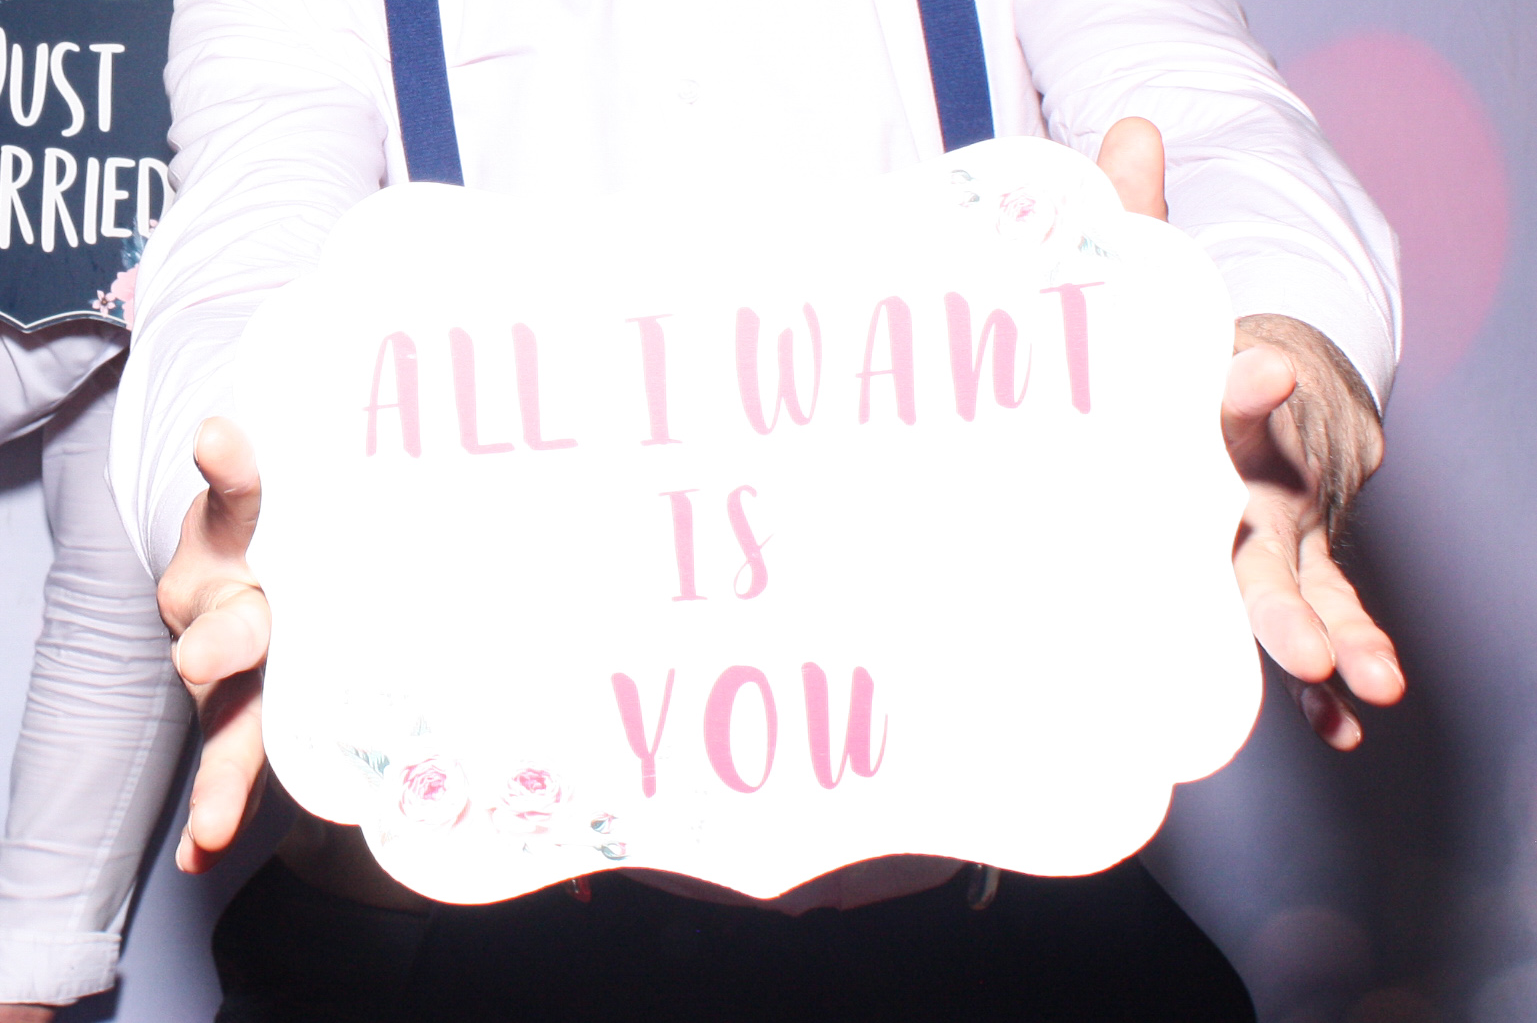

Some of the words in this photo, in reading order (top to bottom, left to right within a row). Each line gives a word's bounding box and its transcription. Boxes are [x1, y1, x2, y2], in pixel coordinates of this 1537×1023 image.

[362, 321, 579, 459] ALL
[625, 313, 683, 447] I
[734, 281, 1105, 436] WANT
[658, 484, 774, 603] IS
[610, 661, 890, 799] YOU
